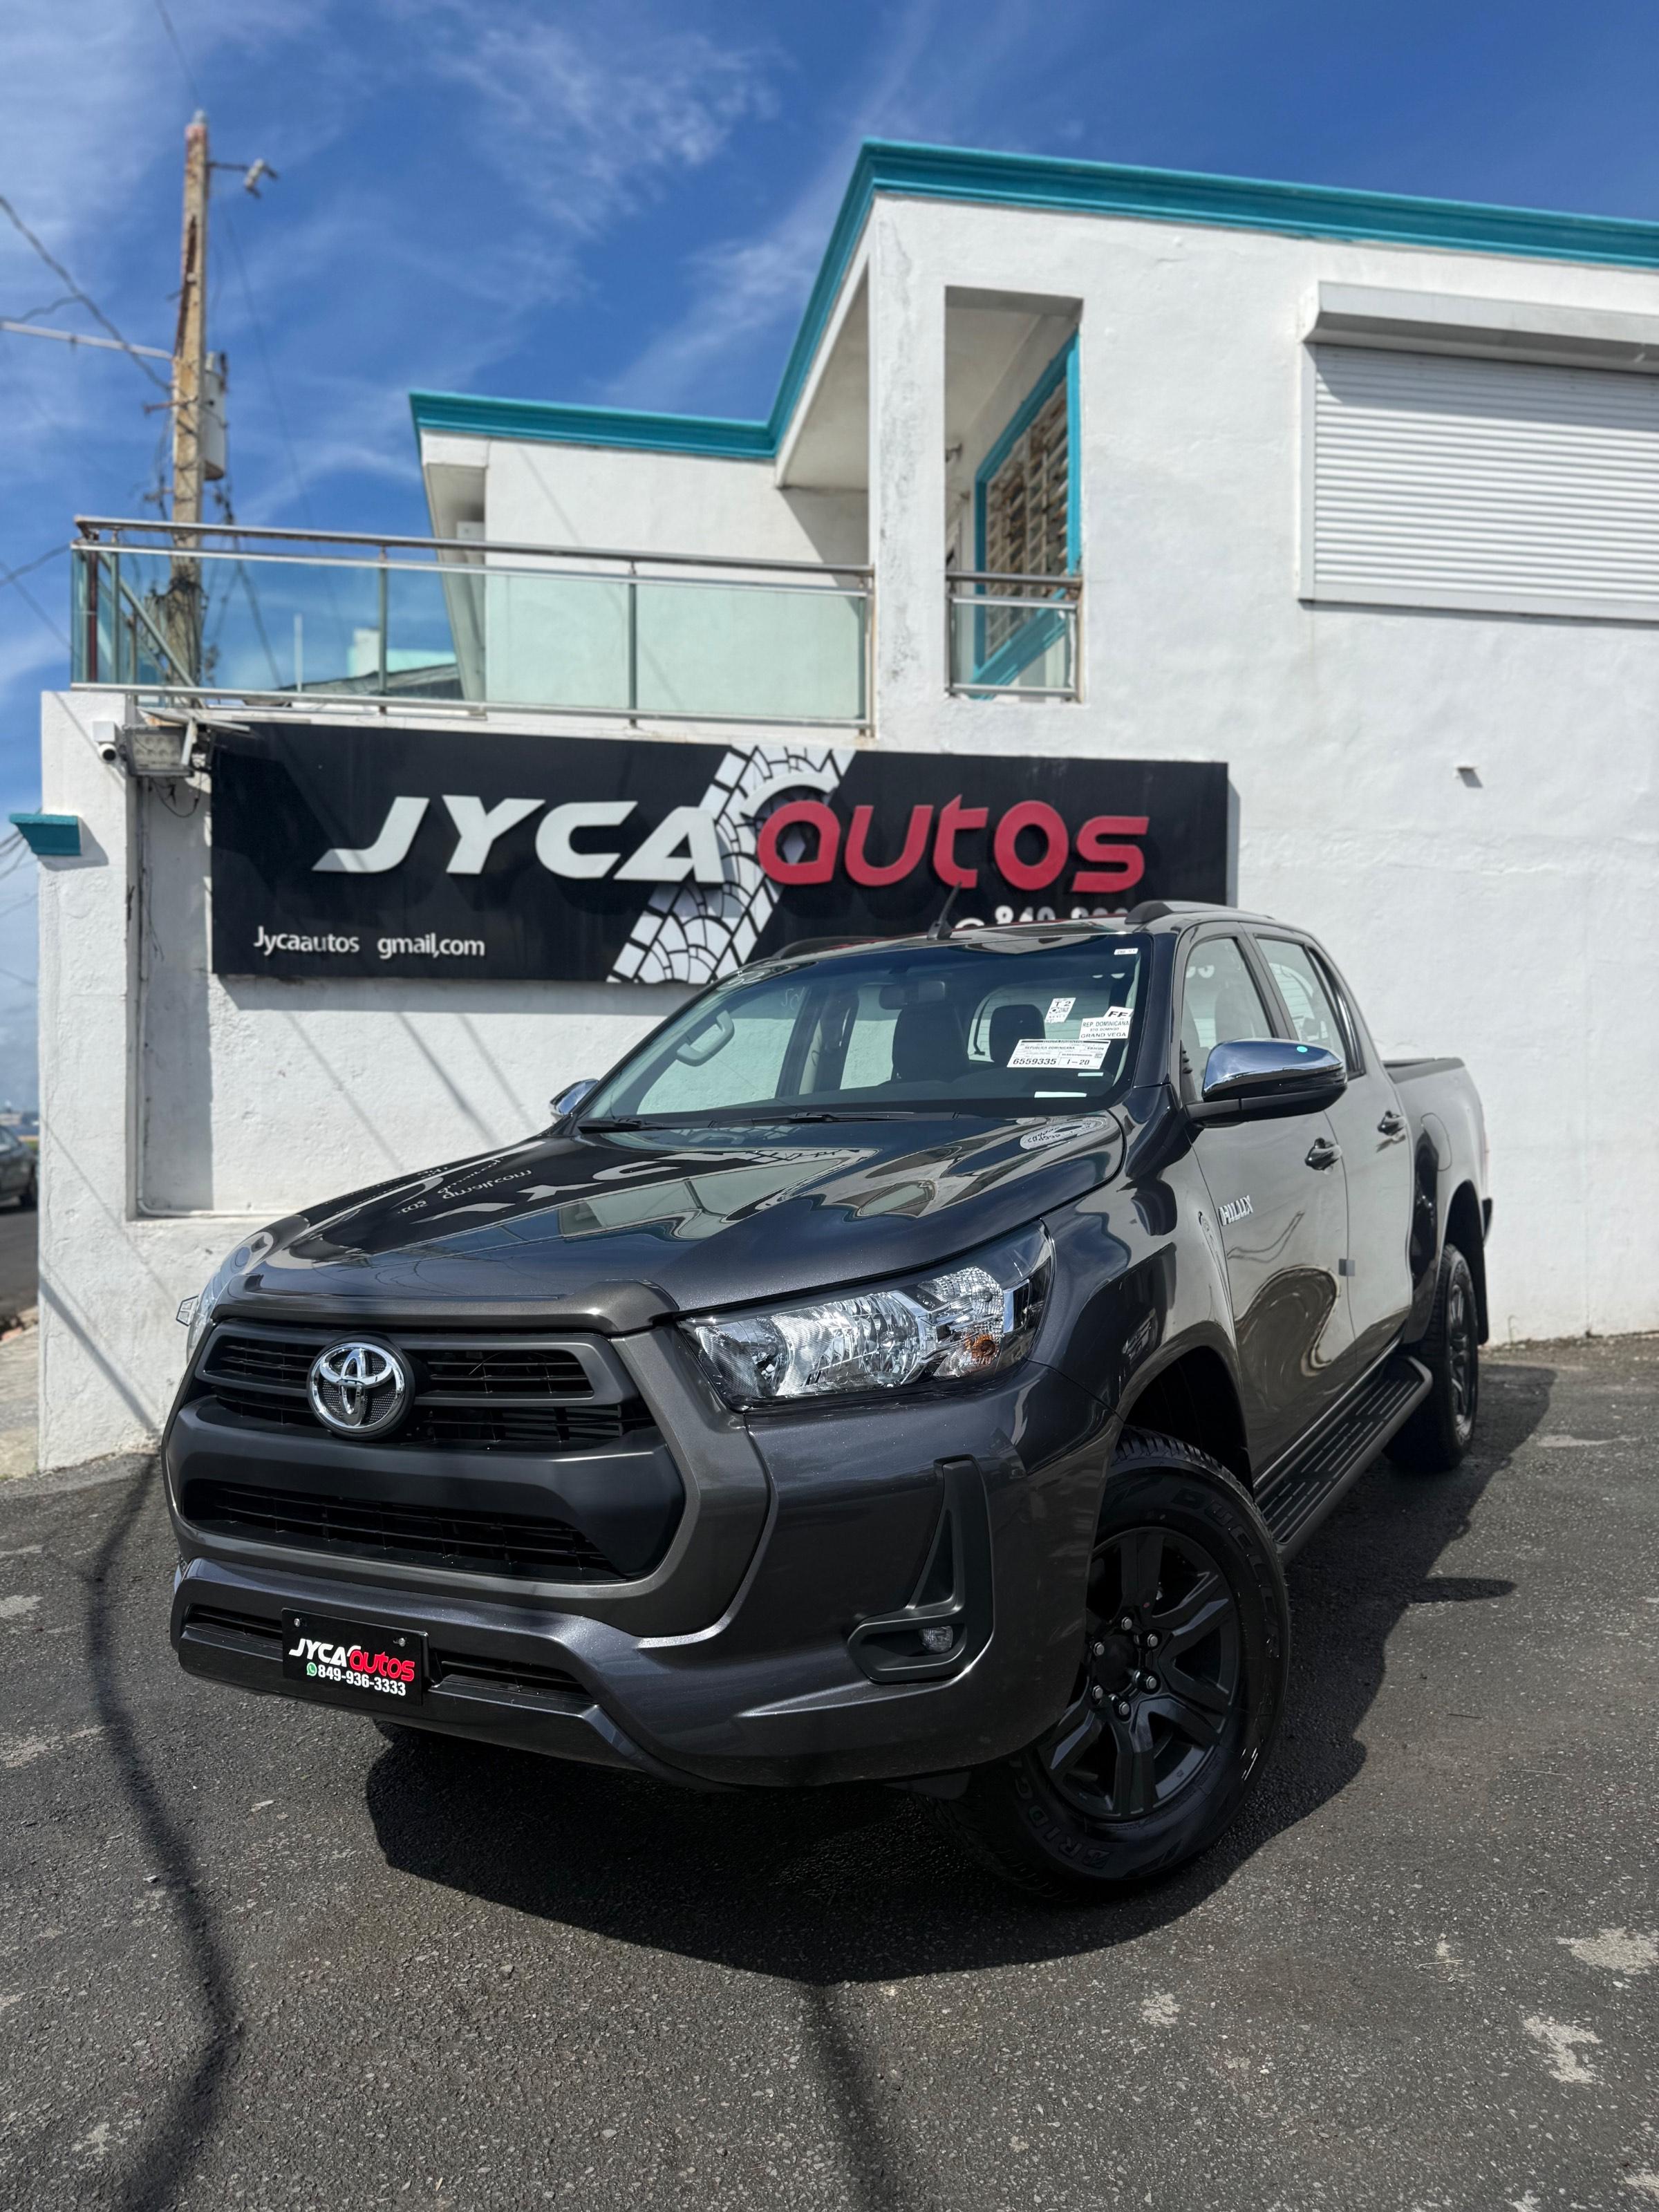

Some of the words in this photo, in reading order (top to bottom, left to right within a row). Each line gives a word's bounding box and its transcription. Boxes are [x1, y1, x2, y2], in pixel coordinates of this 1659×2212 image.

[312, 794, 724, 883] JYCA
[756, 794, 1150, 893] autos
[254, 926, 359, 956] Jycaautos
[1219, 1195, 1253, 1226] HILUX
[317, 1664, 406, 1697] 849-936-3333
